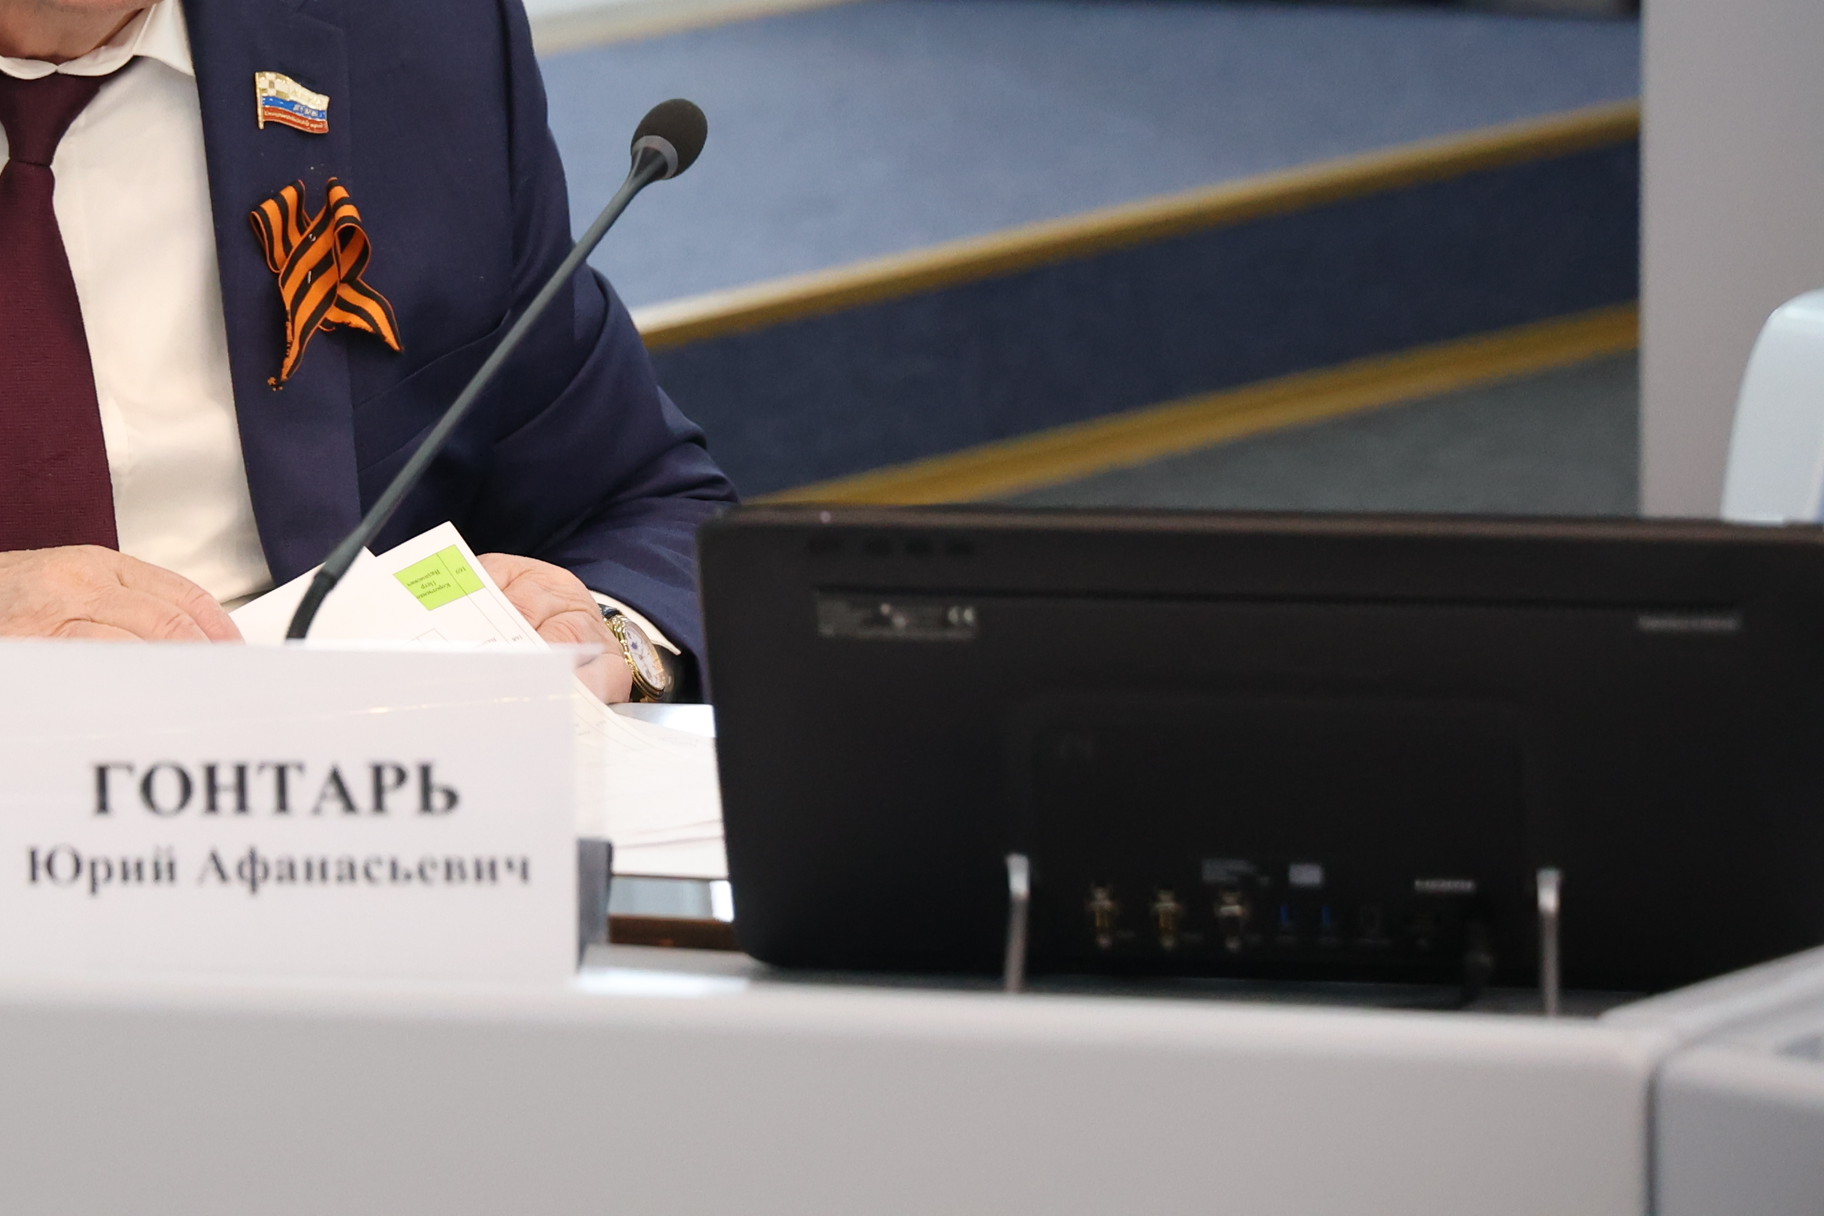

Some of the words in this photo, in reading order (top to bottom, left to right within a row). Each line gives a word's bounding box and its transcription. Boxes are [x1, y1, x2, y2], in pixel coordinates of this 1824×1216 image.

[91, 761, 461, 817] ГОНТАРЬ
[27, 845, 177, 896] Юрий
[197, 845, 532, 896] Афанасьевич
